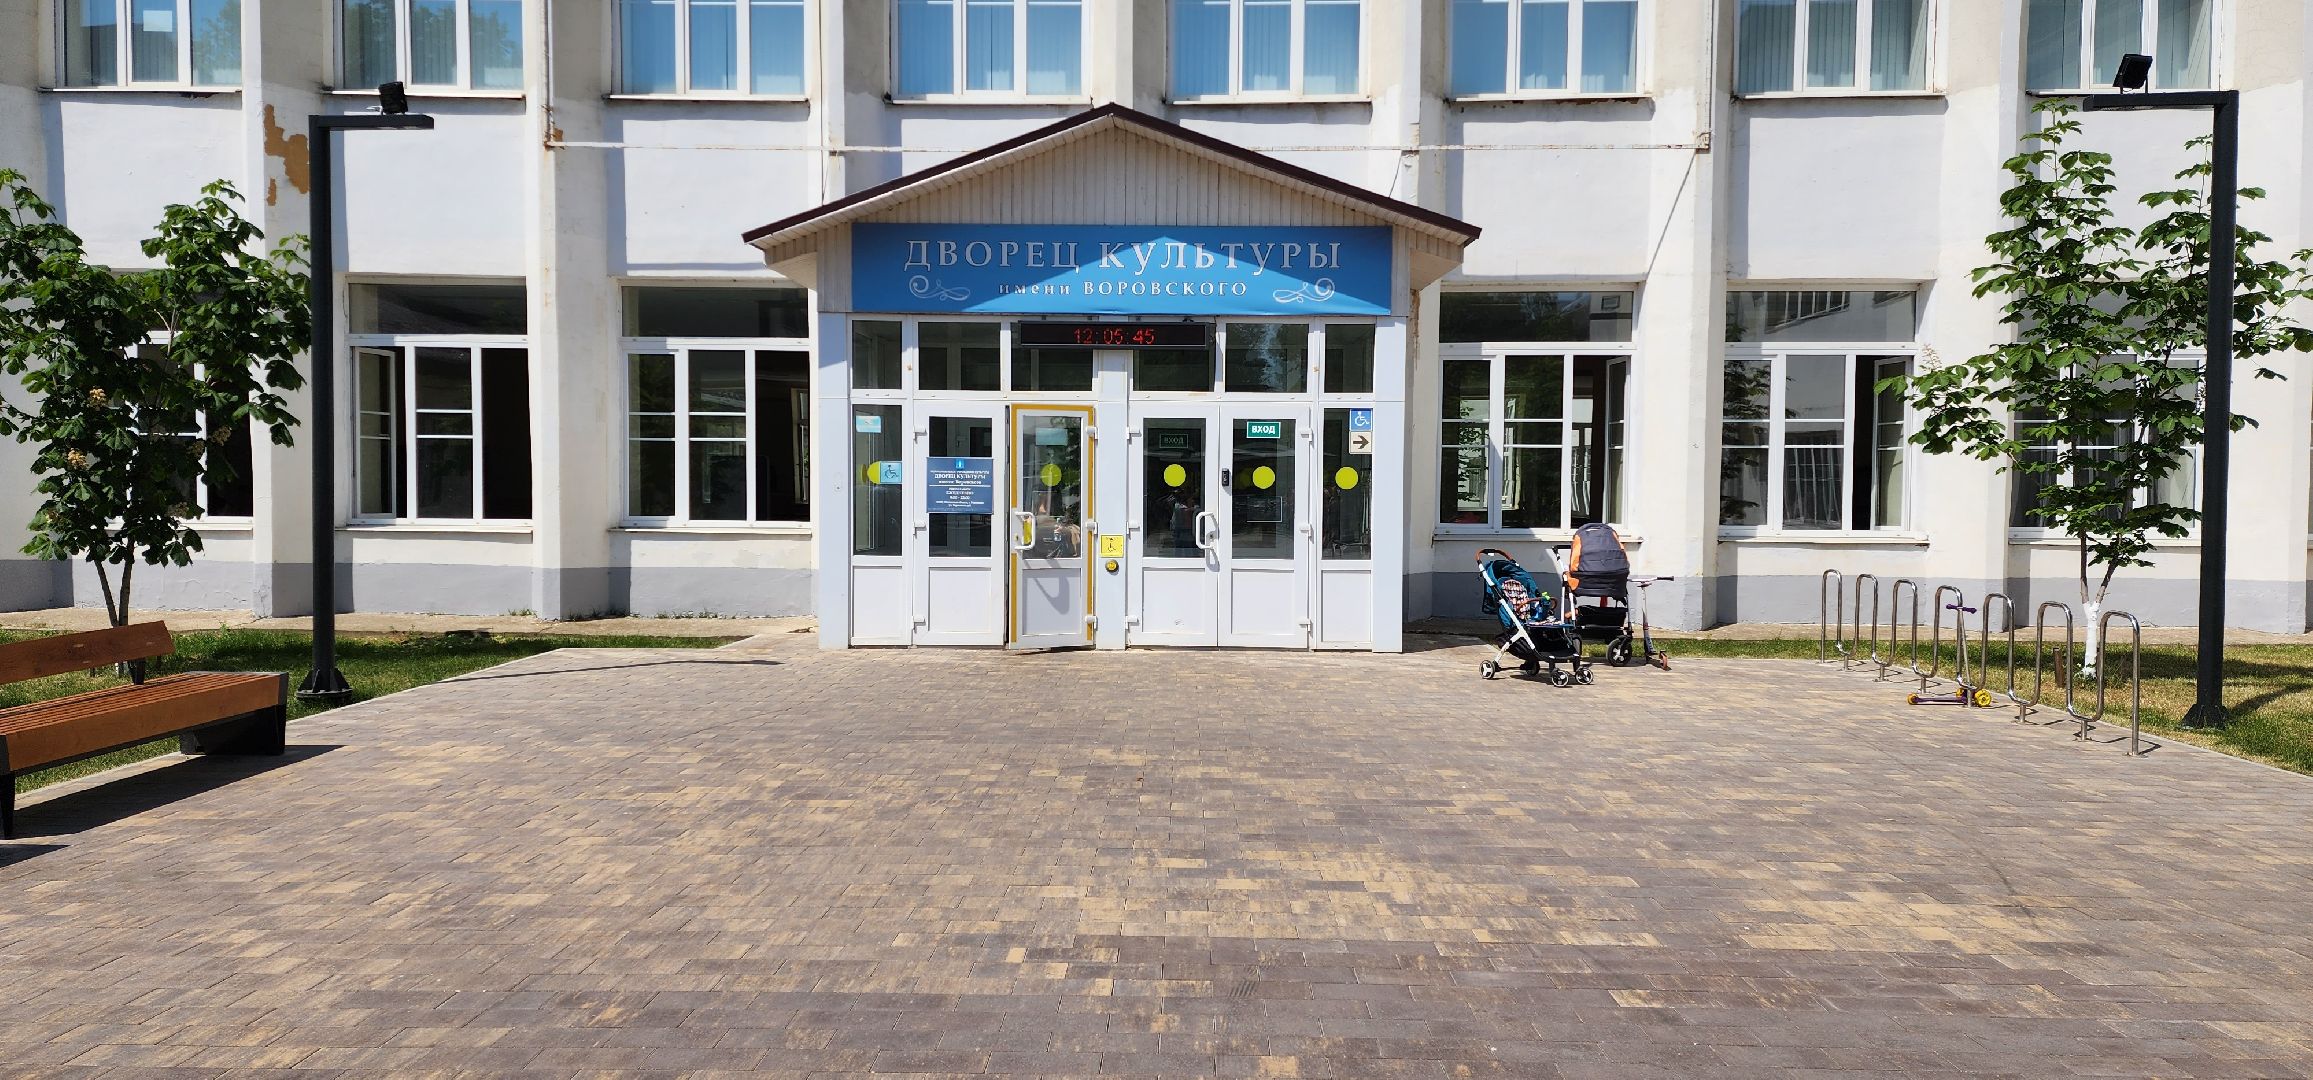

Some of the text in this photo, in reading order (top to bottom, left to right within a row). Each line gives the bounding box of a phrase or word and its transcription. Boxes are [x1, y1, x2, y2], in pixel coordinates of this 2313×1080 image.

[904, 240, 1341, 276] ДВОРЕЦ КУЛЬТУРЫ
[999, 281, 1247, 296] имени ВОРОВСКОГО
[1073, 328, 1155, 345] 12:05:45
[1251, 425, 1276, 435] ВХОД
